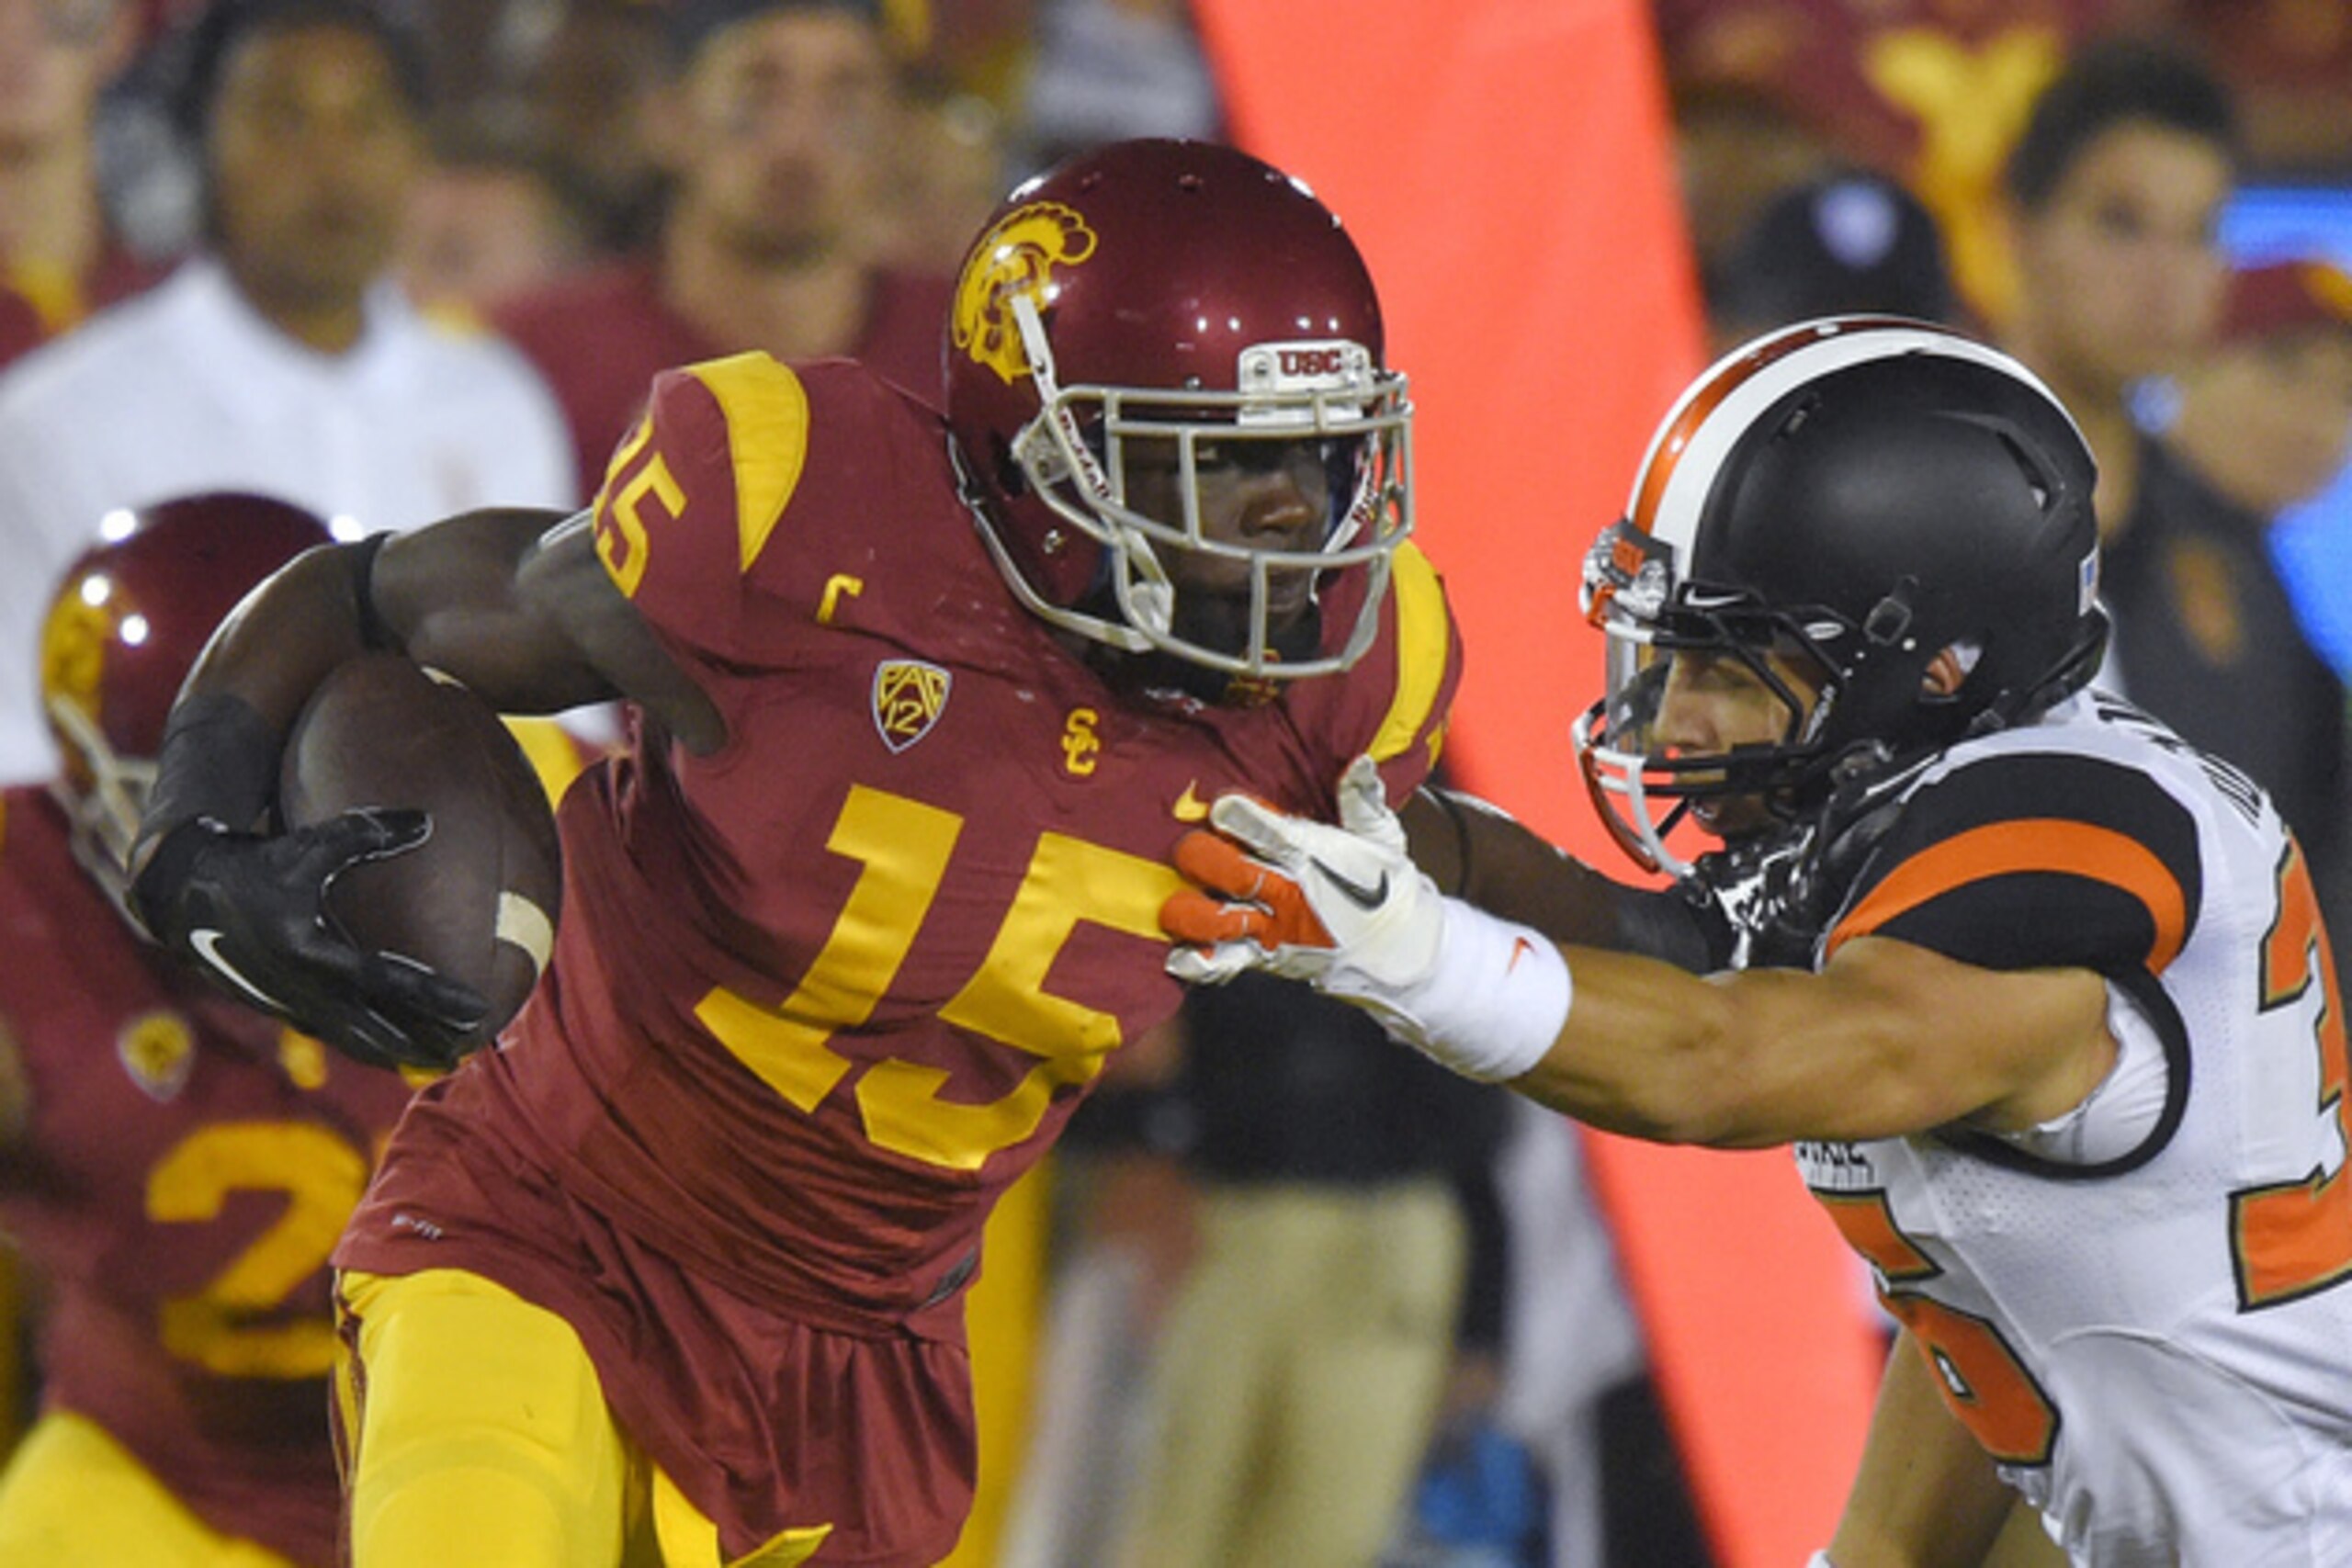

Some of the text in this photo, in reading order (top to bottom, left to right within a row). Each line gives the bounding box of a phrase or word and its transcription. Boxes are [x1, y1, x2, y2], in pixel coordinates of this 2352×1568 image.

[1277, 348, 1342, 377] USC
[878, 664, 948, 721] PAC
[885, 700, 924, 735] 12
[693, 784, 1200, 1171] 15
[144, 1119, 393, 1381] 2
